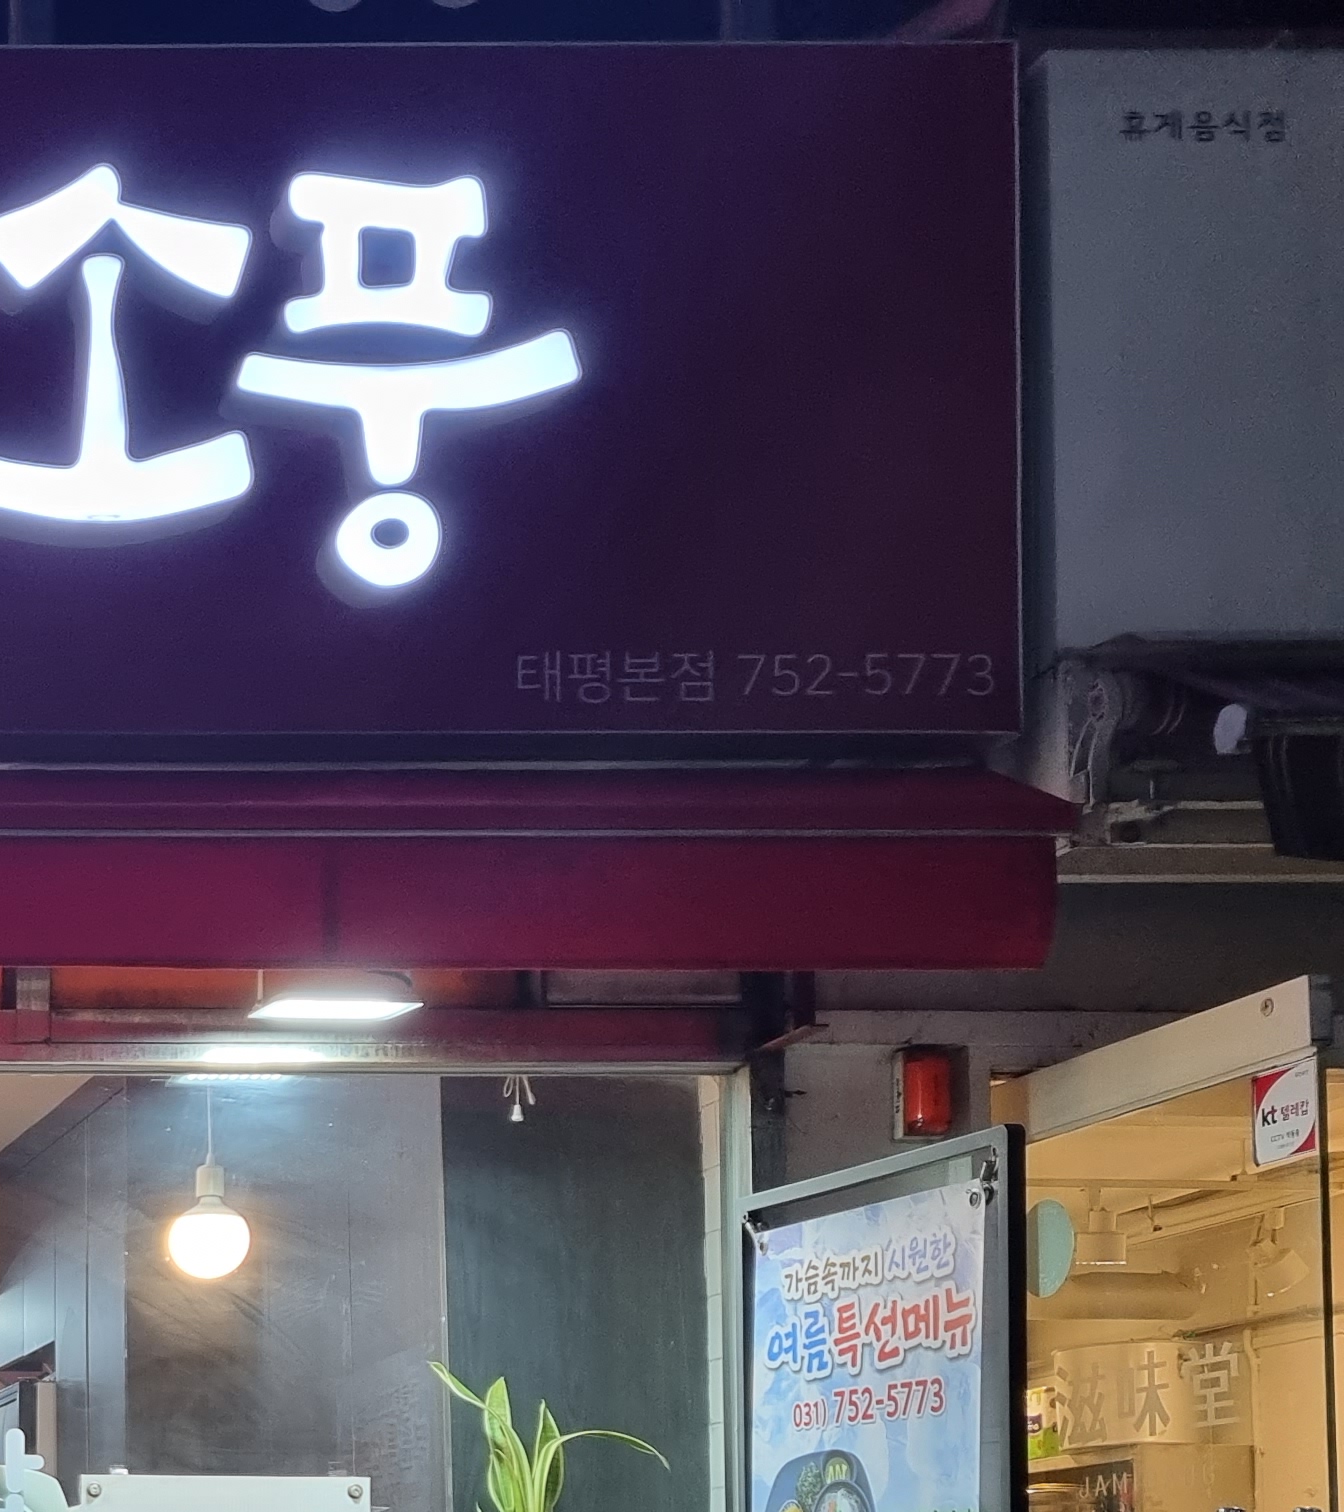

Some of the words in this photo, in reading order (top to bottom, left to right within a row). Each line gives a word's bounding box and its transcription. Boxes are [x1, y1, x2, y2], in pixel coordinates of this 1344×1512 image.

[1119, 108, 1288, 145] 휴게음식점
[514, 651, 715, 706] 태평본점
[736, 651, 996, 699] 752-5773
[1261, 1104, 1278, 1128] kt
[784, 1250, 881, 1297] 가슴속까지
[884, 1231, 953, 1276] 시원한
[793, 1398, 828, 1429] 031)
[832, 1376, 946, 1425] 752-5773
